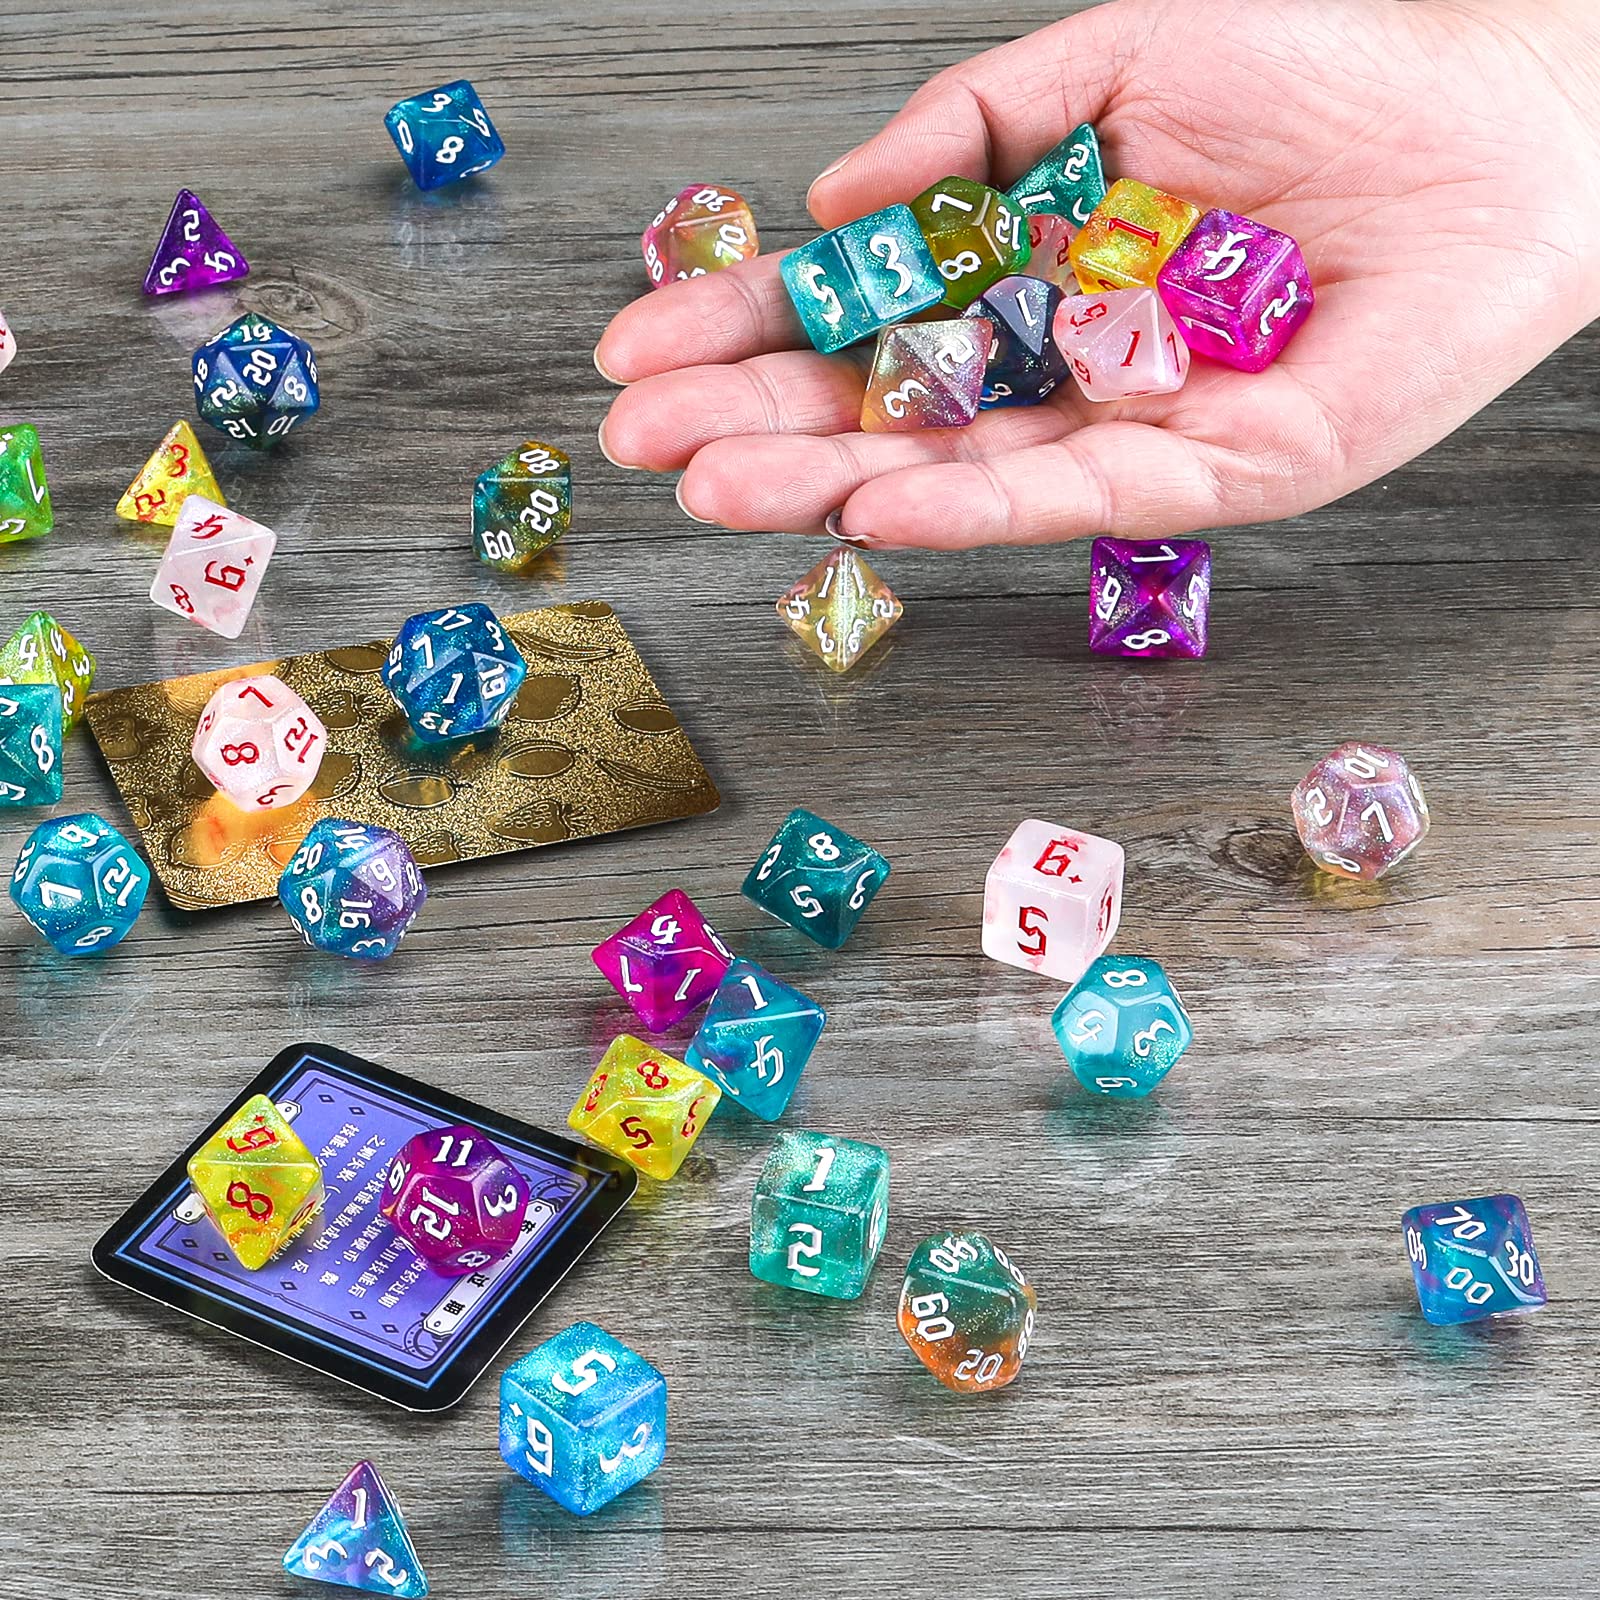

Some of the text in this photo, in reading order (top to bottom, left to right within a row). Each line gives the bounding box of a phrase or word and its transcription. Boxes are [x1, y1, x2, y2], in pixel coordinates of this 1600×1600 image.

[421, 94, 452, 112] 3
[436, 136, 464, 164] 8
[1064, 143, 1090, 181] 2
[692, 188, 736, 212] 30
[183, 210, 200, 241] 2
[714, 224, 748, 261] 70
[995, 206, 1021, 251] 12
[1107, 216, 1160, 247] 1
[160, 257, 191, 286] 3
[204, 250, 235, 273] 4
[645, 243, 664, 282] 90
[869, 234, 913, 298] 3
[939, 250, 982, 280] 8
[1203, 230, 1254, 281] 4
[805, 264, 845, 325] 5
[1015, 289, 1038, 327] 1
[1259, 280, 1298, 336] 2
[242, 323, 273, 342] 14
[1120, 330, 1142, 369] 1
[243, 350, 278, 386] 20
[935, 334, 977, 374] 2
[210, 379, 238, 408] 2
[284, 376, 307, 402] 8
[882, 378, 930, 419] 3
[223, 418, 257, 438] 12
[267, 415, 299, 435] 10
[169, 444, 189, 477] 3
[519, 448, 560, 474] 80
[191, 513, 228, 540] 4
[520, 489, 559, 534] 20
[481, 529, 516, 560] 60
[817, 566, 835, 598] 1
[1182, 574, 1209, 618] 5
[432, 609, 472, 631] 17
[785, 599, 811, 619] 4
[412, 634, 434, 669] 7
[485, 620, 505, 652] 3
[815, 616, 835, 654] 3
[1121, 629, 1172, 650] 8
[19, 635, 38, 671] 4
[72, 655, 89, 675] 3
[442, 672, 464, 704] 1
[479, 662, 506, 699] 19
[284, 717, 319, 764] 12
[419, 711, 454, 736] 13
[31, 724, 55, 774] 8
[221, 742, 260, 766] 8
[1343, 748, 1389, 779] 10
[1305, 786, 1334, 827] 2
[1361, 801, 1394, 843] 7
[332, 825, 370, 852] 14
[808, 831, 840, 861] 8
[292, 842, 324, 875] 20
[756, 844, 782, 881] 2
[1322, 850, 1362, 873] 8
[38, 879, 82, 908] 7
[102, 856, 141, 907] 12
[848, 869, 876, 910] 3
[301, 886, 323, 924] 8
[339, 896, 372, 929] 16
[789, 885, 824, 918] 5
[75, 926, 112, 948] 8
[650, 914, 682, 945] 4
[1017, 905, 1048, 957] 5
[674, 968, 701, 1001] 1
[742, 976, 769, 1011] 1
[1101, 969, 1149, 989] 8
[1068, 1009, 1107, 1045] 4
[1133, 1018, 1176, 1057] 3
[637, 1060, 670, 1090] 8
[750, 1035, 785, 1088] 4
[620, 1115, 654, 1150] 5
[432, 1134, 475, 1168] 11
[802, 1147, 836, 1192] 1
[226, 1181, 275, 1221] 8
[409, 1186, 460, 1241] 12
[483, 1184, 519, 1219] 3
[1435, 1206, 1487, 1240] 70
[456, 1250, 492, 1268] 8
[786, 1222, 822, 1277] 2
[928, 1237, 979, 1274] 40
[1504, 1240, 1534, 1286] 30
[443, 1219, 537, 1316] 药过期
[1444, 1266, 1494, 1305] 00
[911, 1292, 956, 1342] 60
[550, 1347, 617, 1396] 5
[953, 1349, 1005, 1384] 20
[599, 1421, 653, 1475] 3
[350, 1488, 367, 1530] 1
[303, 1539, 348, 1570] 3
[364, 1548, 408, 1587] 2
